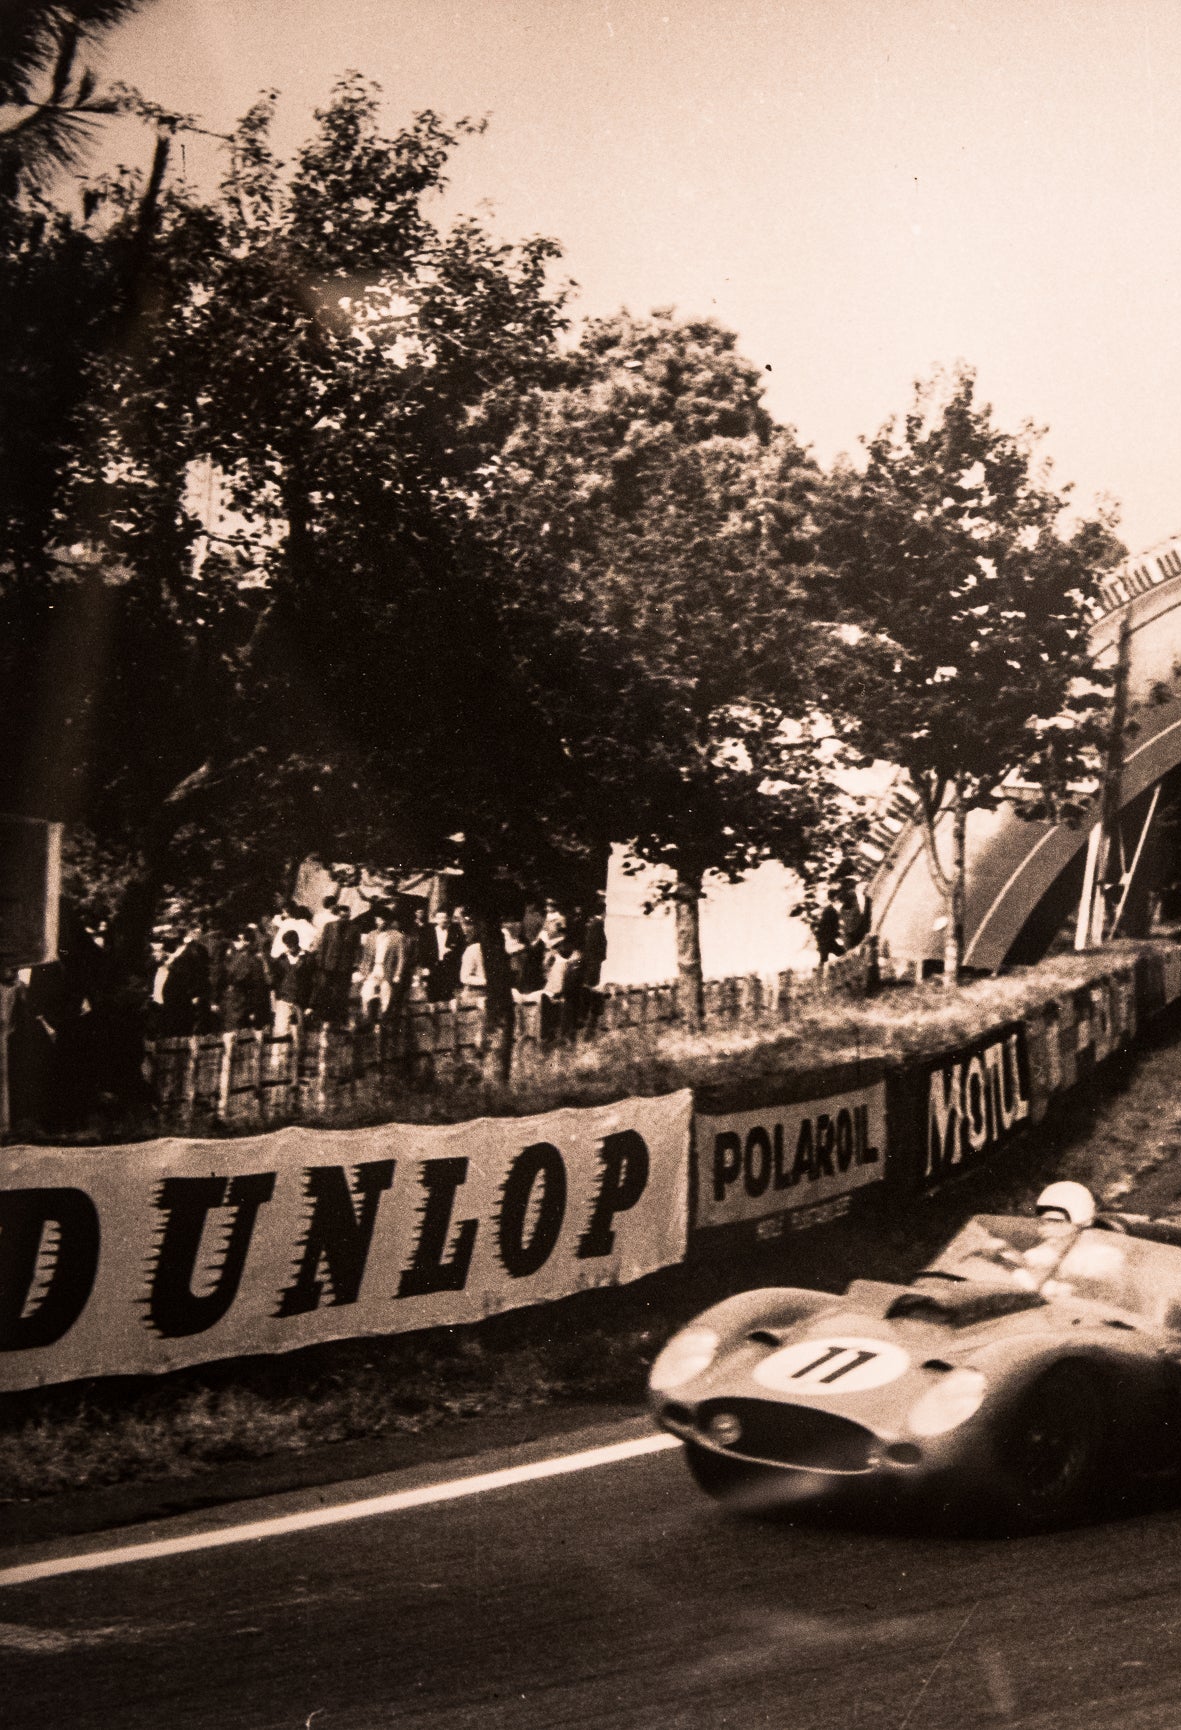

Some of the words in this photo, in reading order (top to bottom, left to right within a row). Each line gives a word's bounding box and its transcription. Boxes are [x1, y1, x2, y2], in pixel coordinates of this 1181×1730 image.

[713, 1103, 878, 1202] POLAROIL
[0, 1129, 650, 1352] DUNLOP
[791, 1346, 878, 1383] 11
